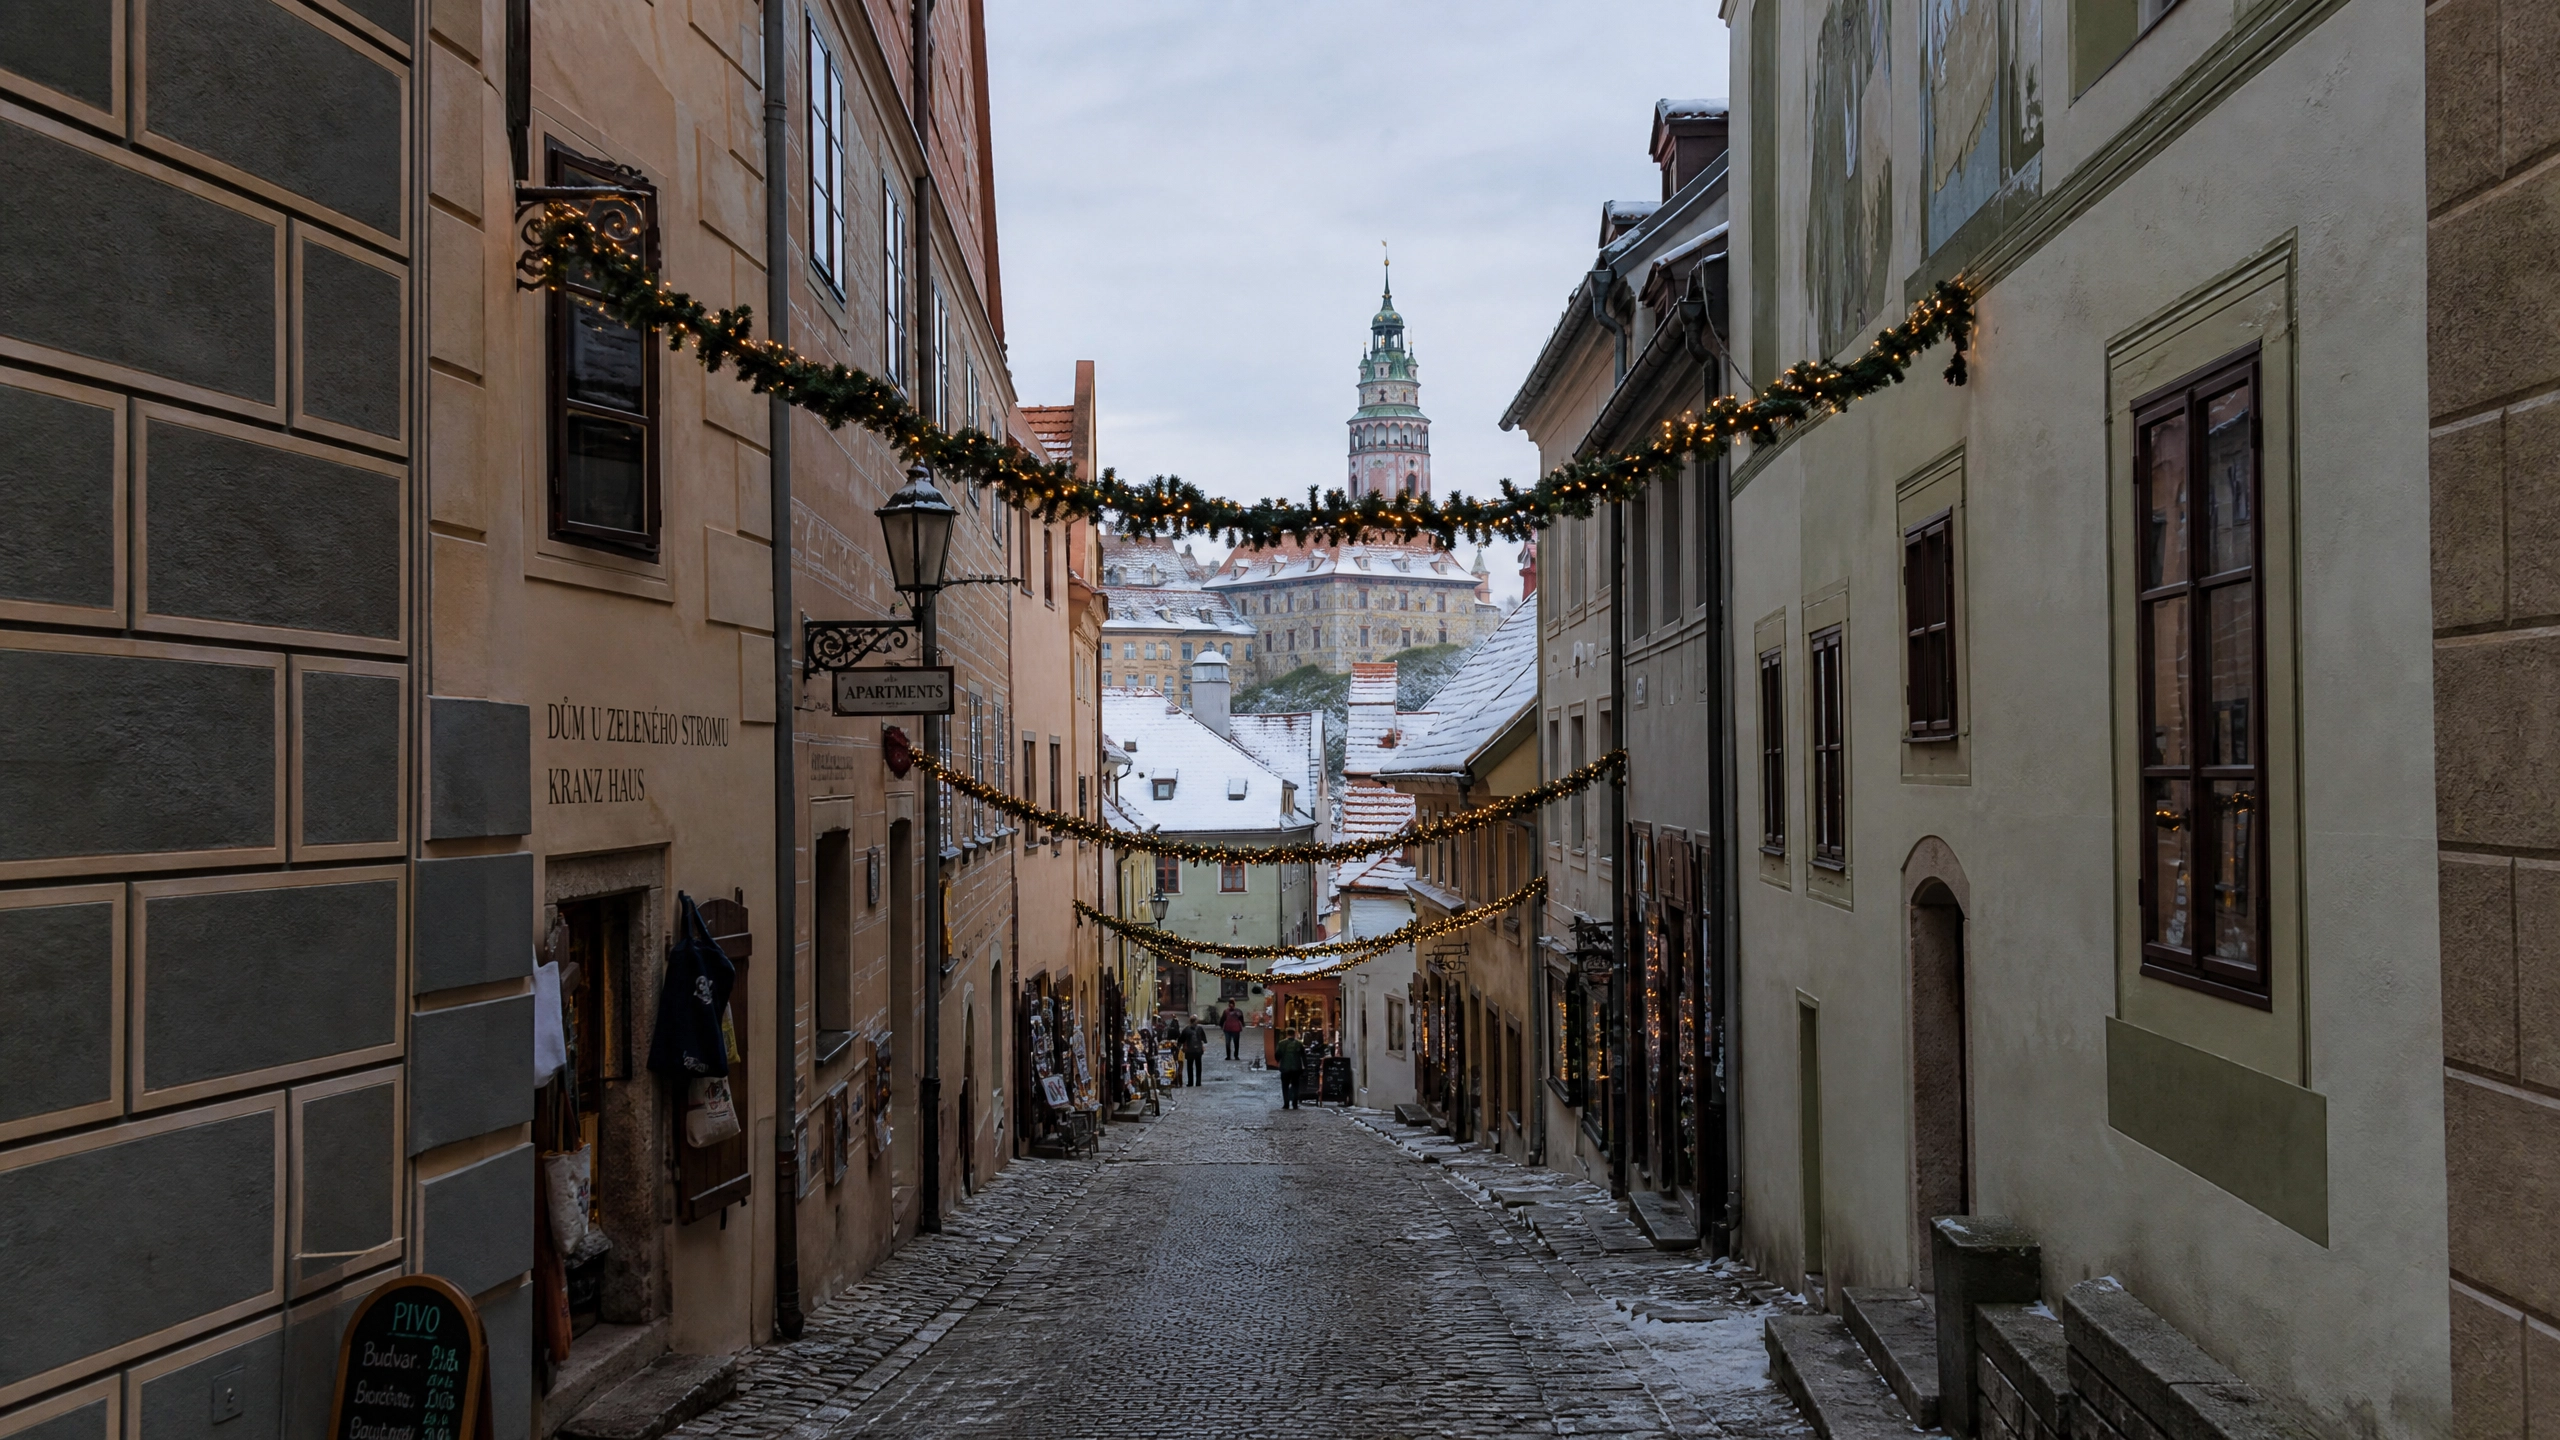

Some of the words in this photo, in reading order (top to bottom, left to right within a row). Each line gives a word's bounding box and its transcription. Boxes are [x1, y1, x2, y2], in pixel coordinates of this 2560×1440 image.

[845, 685, 943, 699] APARTMENTS
[548, 696, 585, 741] DŮM
[591, 706, 601, 741] U
[607, 705, 678, 745] ZELENÉHO
[682, 714, 729, 747] STROMU
[548, 768, 603, 804] KRANZ
[608, 768, 645, 802] HAUS
[392, 1302, 441, 1333] PIVO
